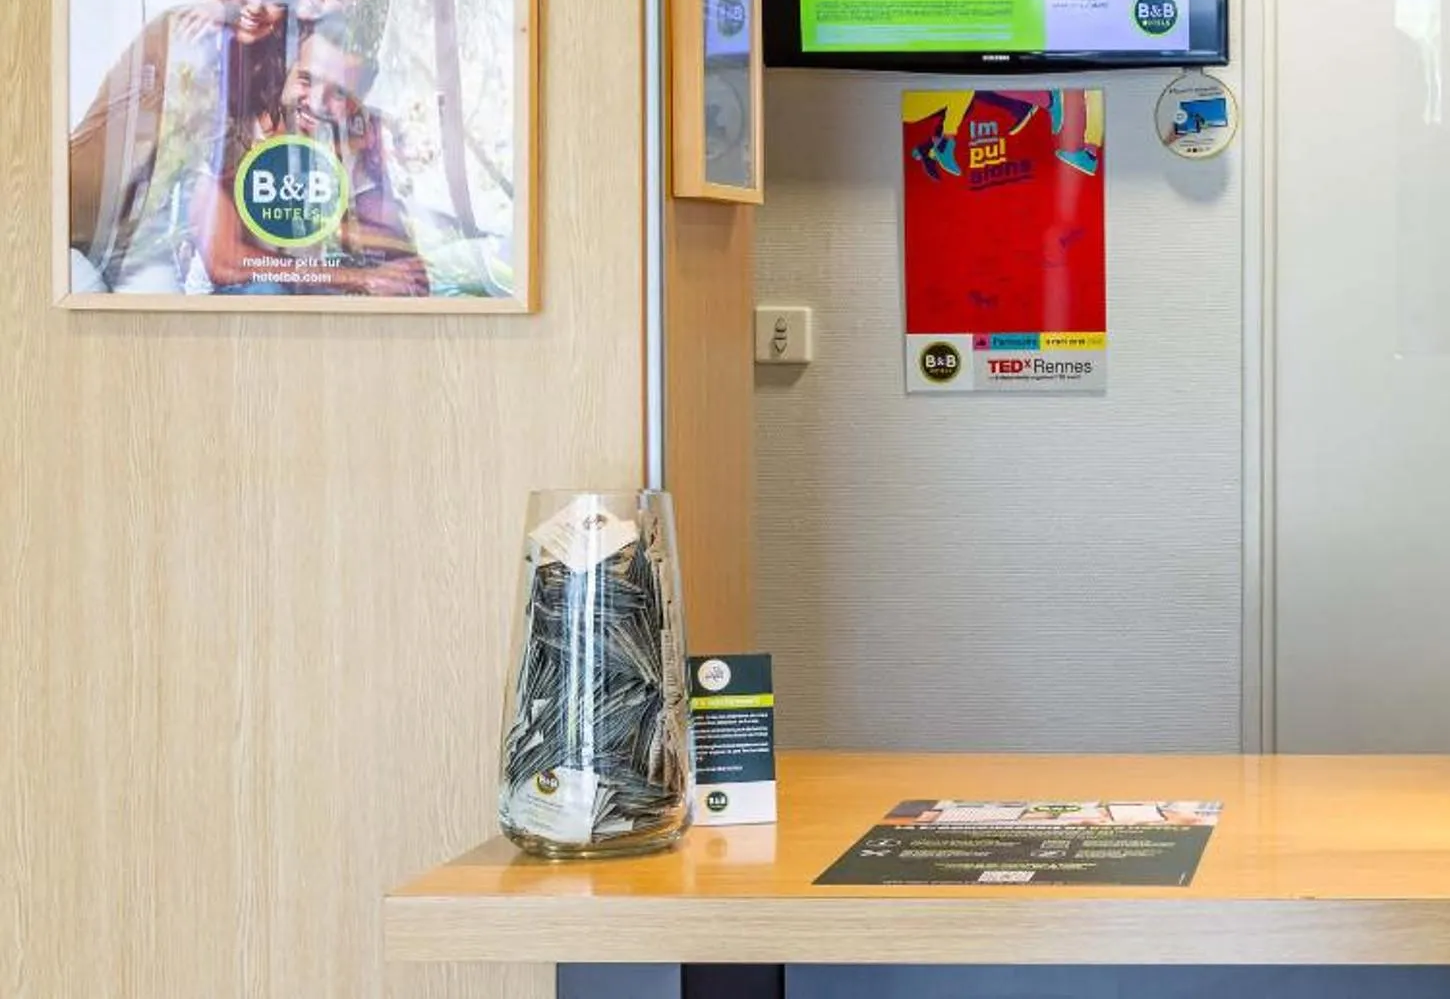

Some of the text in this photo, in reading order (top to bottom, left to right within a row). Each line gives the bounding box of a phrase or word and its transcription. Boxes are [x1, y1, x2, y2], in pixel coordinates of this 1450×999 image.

[1138, 2, 1175, 19] B&B
[970, 137, 1007, 168] pul
[252, 169, 332, 204] B&B
[261, 207, 322, 221] HOTELS
[242, 255, 292, 268] meilleur
[252, 271, 331, 283] hotelbb.com
[925, 354, 957, 368] B&B
